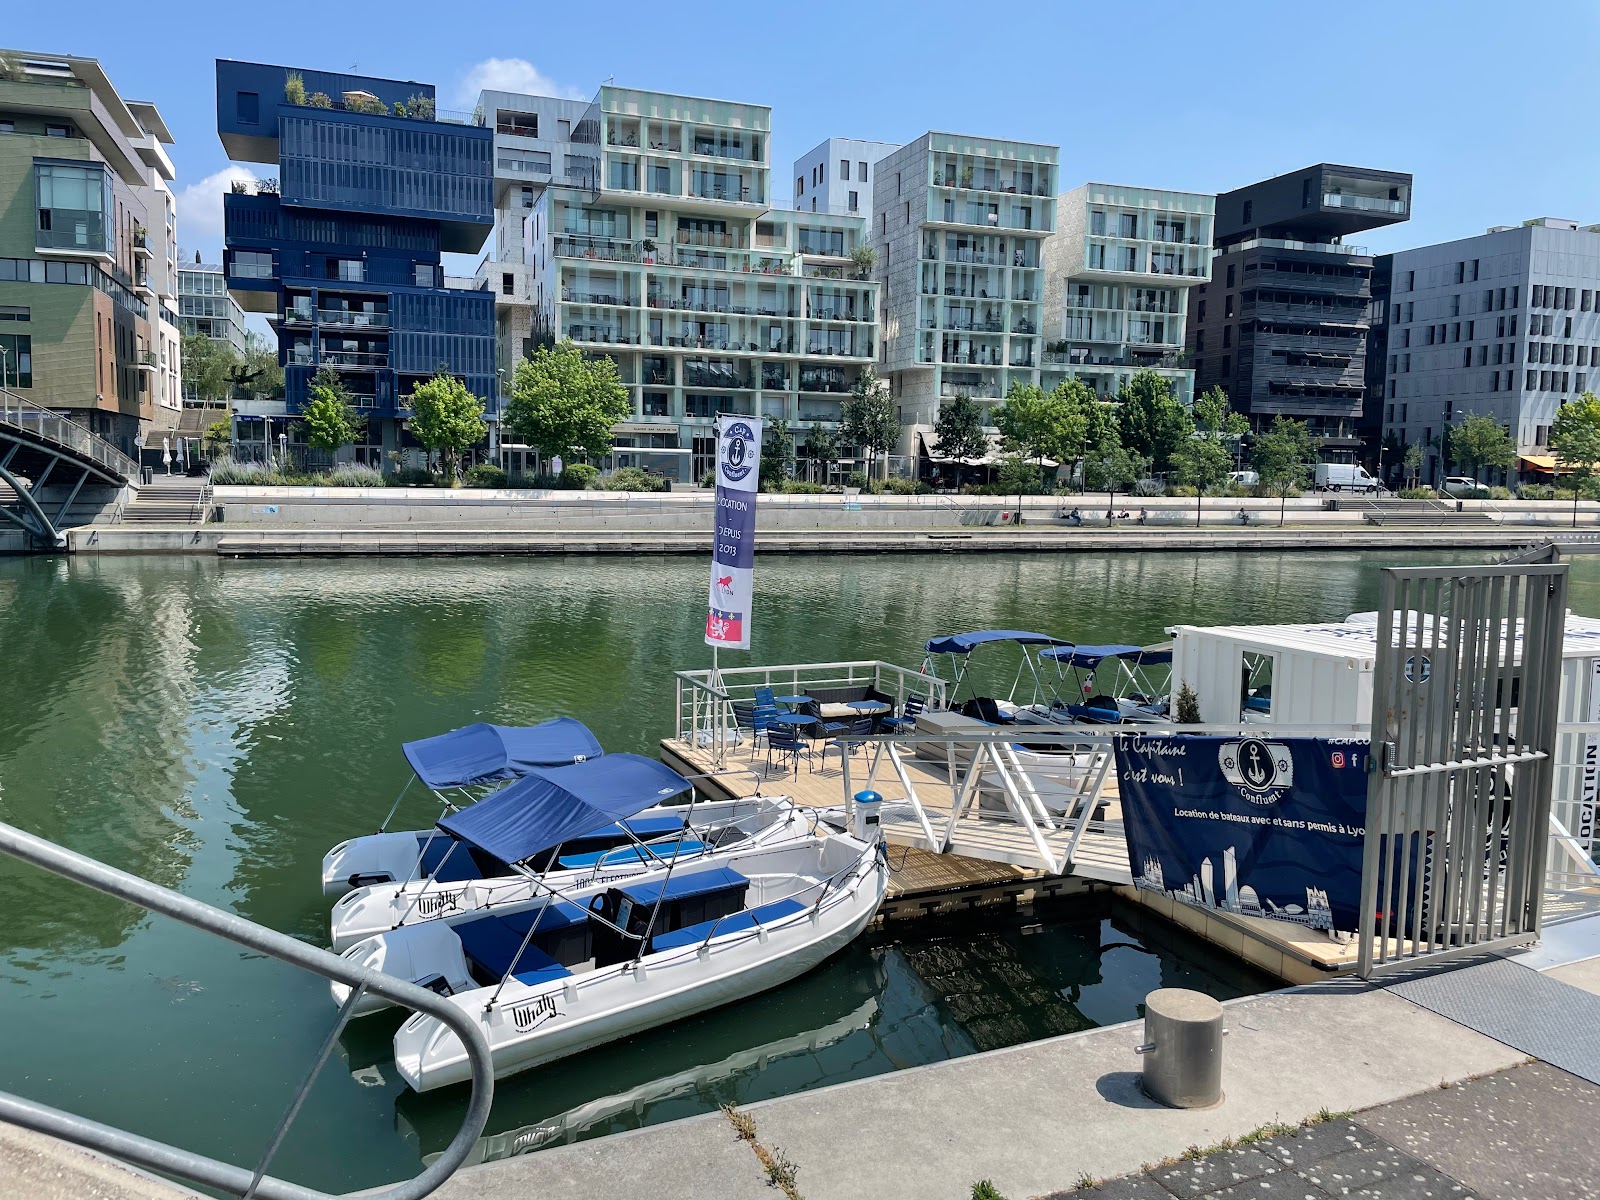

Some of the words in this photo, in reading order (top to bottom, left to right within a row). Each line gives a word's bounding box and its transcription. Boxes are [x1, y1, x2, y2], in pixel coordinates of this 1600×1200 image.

[718, 497, 747, 511] LOCATION
[719, 525, 741, 540] DEPUIS
[719, 543, 736, 557] 2013
[1132, 732, 1186, 759] Capitaine
[1327, 737, 1370, 745] #CAPCO
[1123, 763, 1147, 783] c'est
[1151, 773, 1176, 786] vous
[1240, 787, 1281, 804] Confluent
[1581, 745, 1597, 850] LOCATION
[1174, 807, 1208, 819] Location
[1208, 810, 1219, 820] de
[1219, 811, 1250, 824] bateaux
[1250, 816, 1272, 825] avec
[1272, 817, 1283, 826] et
[1283, 819, 1306, 829] sans
[1307, 821, 1337, 833] permis
[1338, 823, 1345, 834] à
[1346, 825, 1366, 837] Lyo
[512, 994, 557, 1028] Whaly
